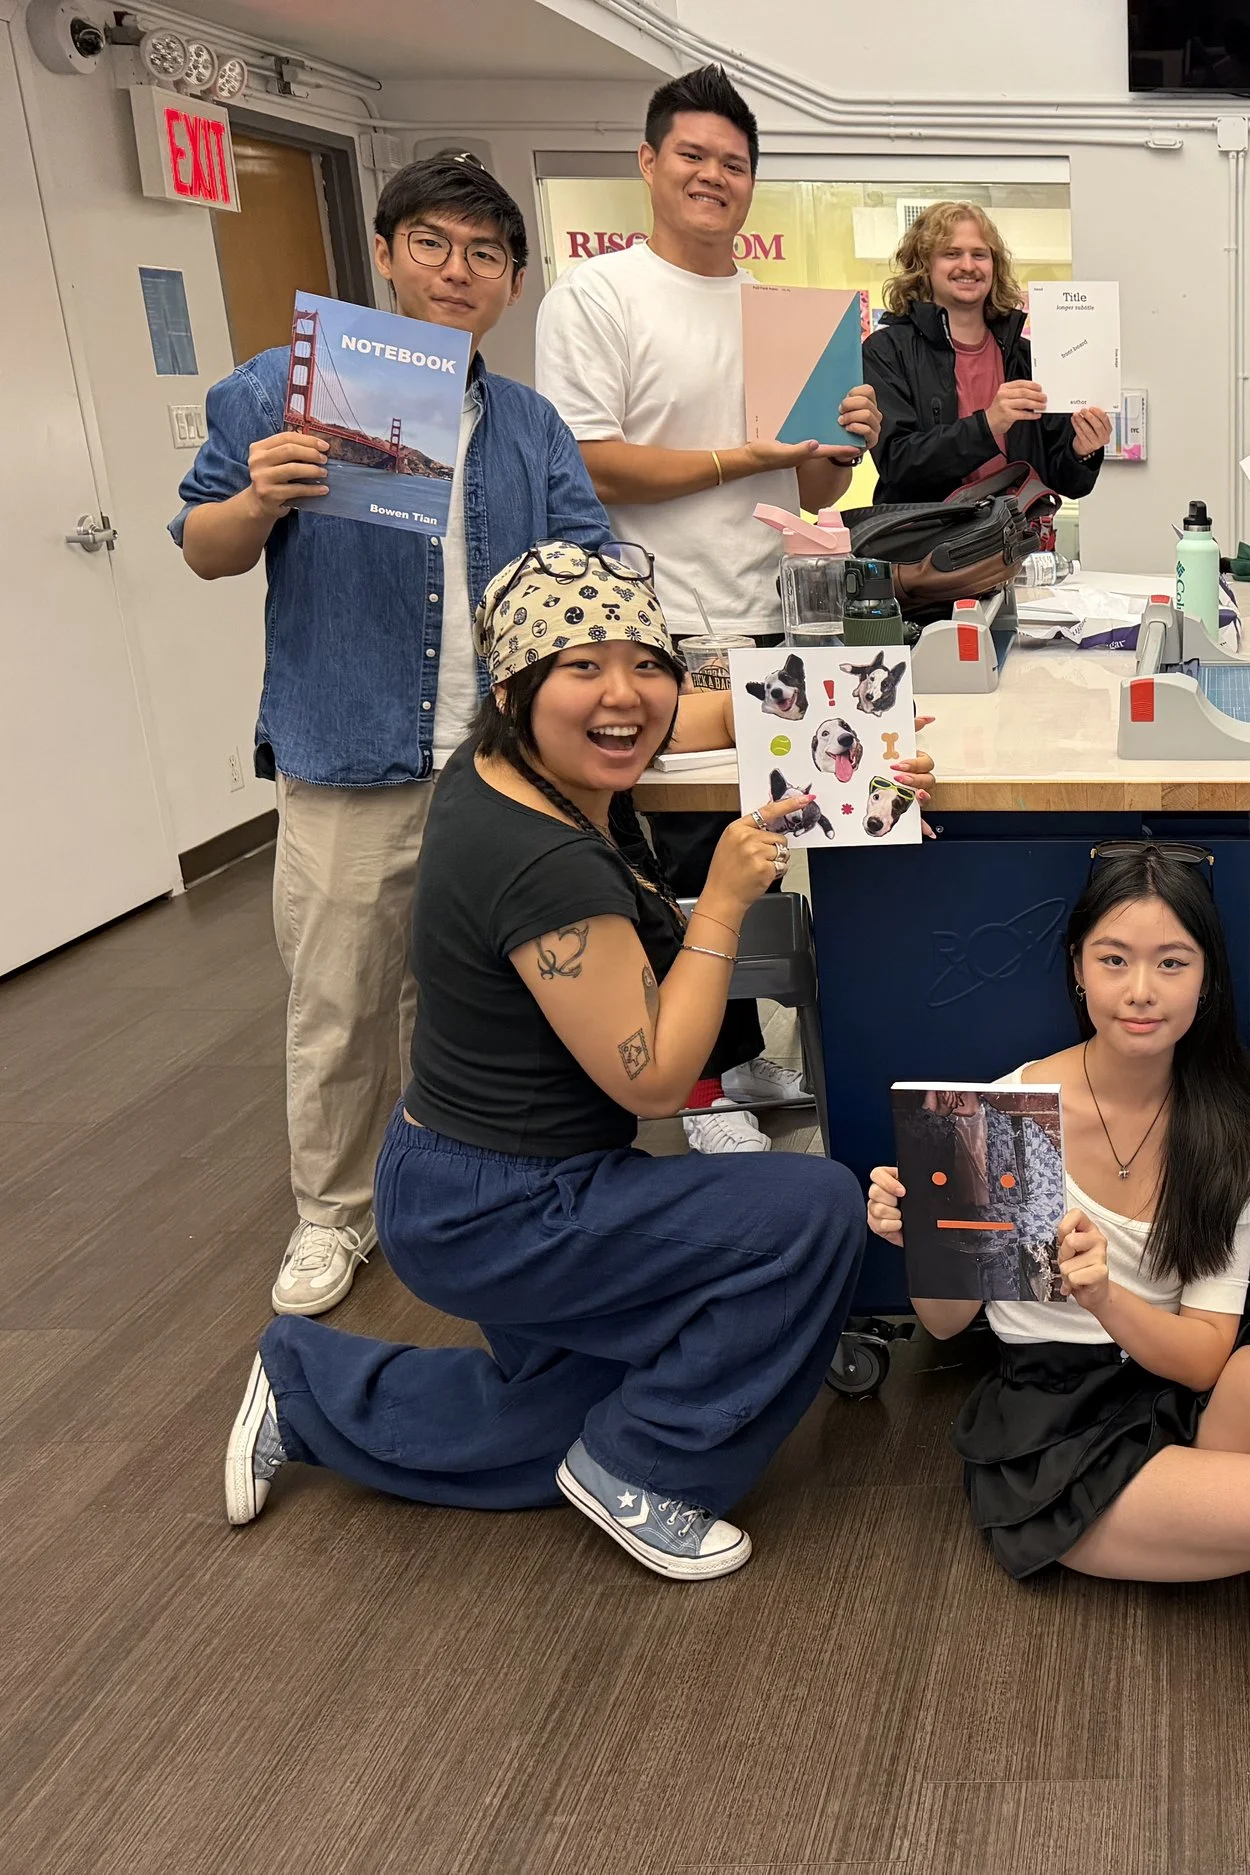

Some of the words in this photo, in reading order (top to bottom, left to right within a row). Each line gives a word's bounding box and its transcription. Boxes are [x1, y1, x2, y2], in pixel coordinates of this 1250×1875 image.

[164, 107, 231, 204] EXIT
[732, 233, 786, 260] OM
[1056, 304, 1074, 312] longer
[1063, 292, 1087, 302] Title
[341, 334, 457, 374] NOTEBOOK
[369, 503, 409, 520] Bowen
[411, 512, 437, 525] Tian
